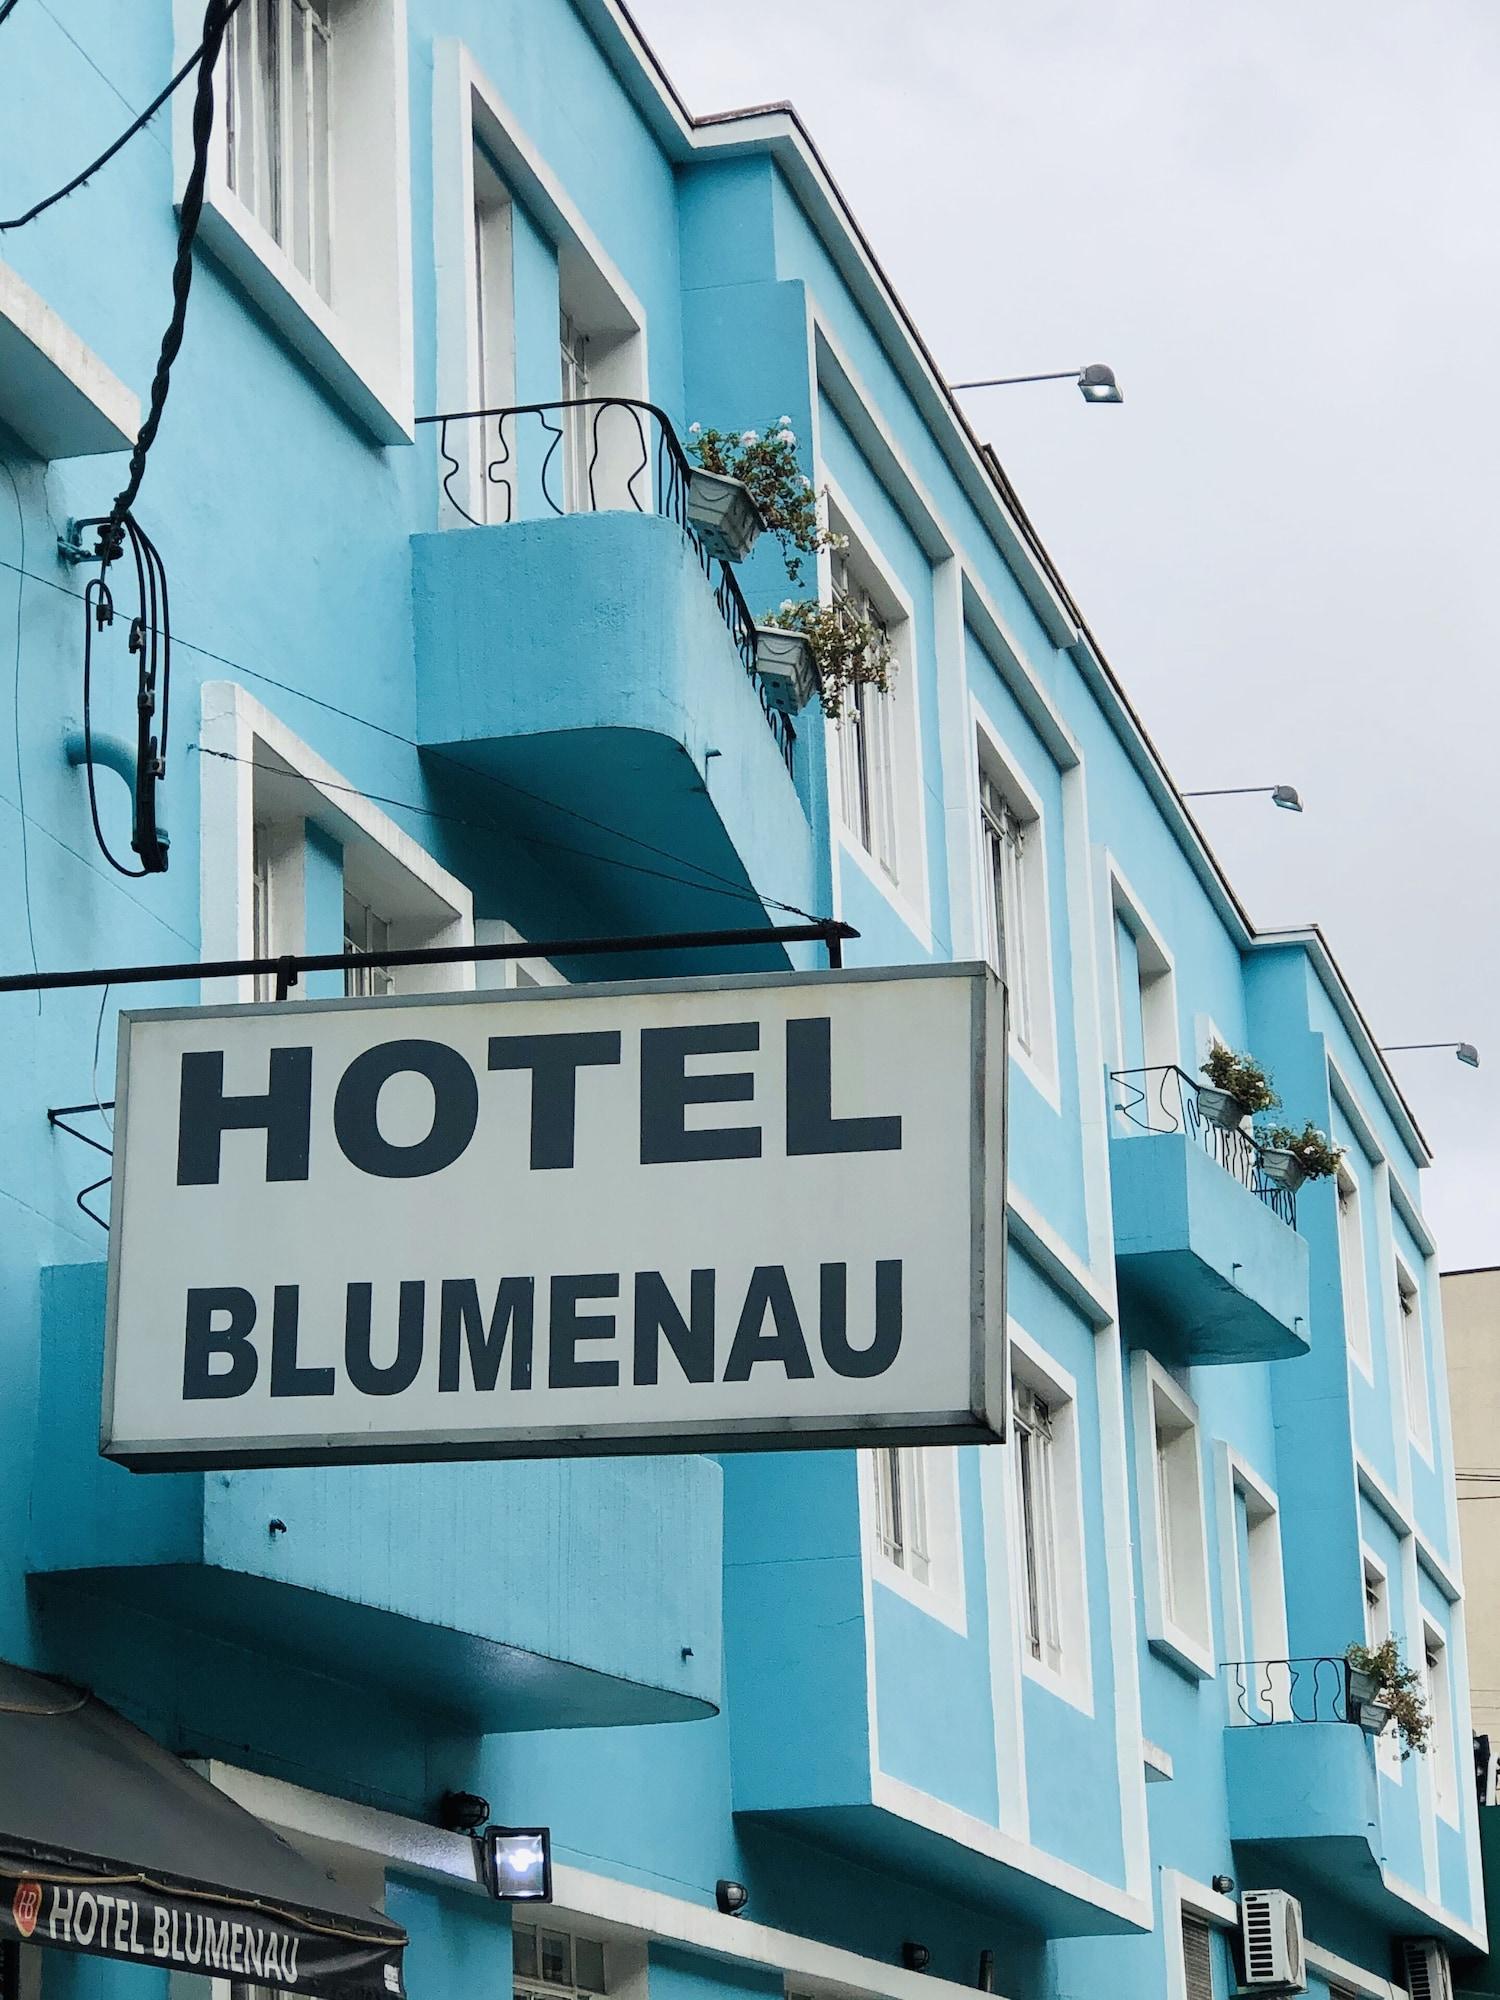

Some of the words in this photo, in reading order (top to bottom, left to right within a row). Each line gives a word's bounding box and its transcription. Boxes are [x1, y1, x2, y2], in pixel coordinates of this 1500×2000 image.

[176, 1016, 903, 1187] HOTEL
[182, 1259, 904, 1401] BLUMENAU
[48, 1886, 145, 1956] HOTEL
[153, 1906, 300, 1985] BLUMENAU
